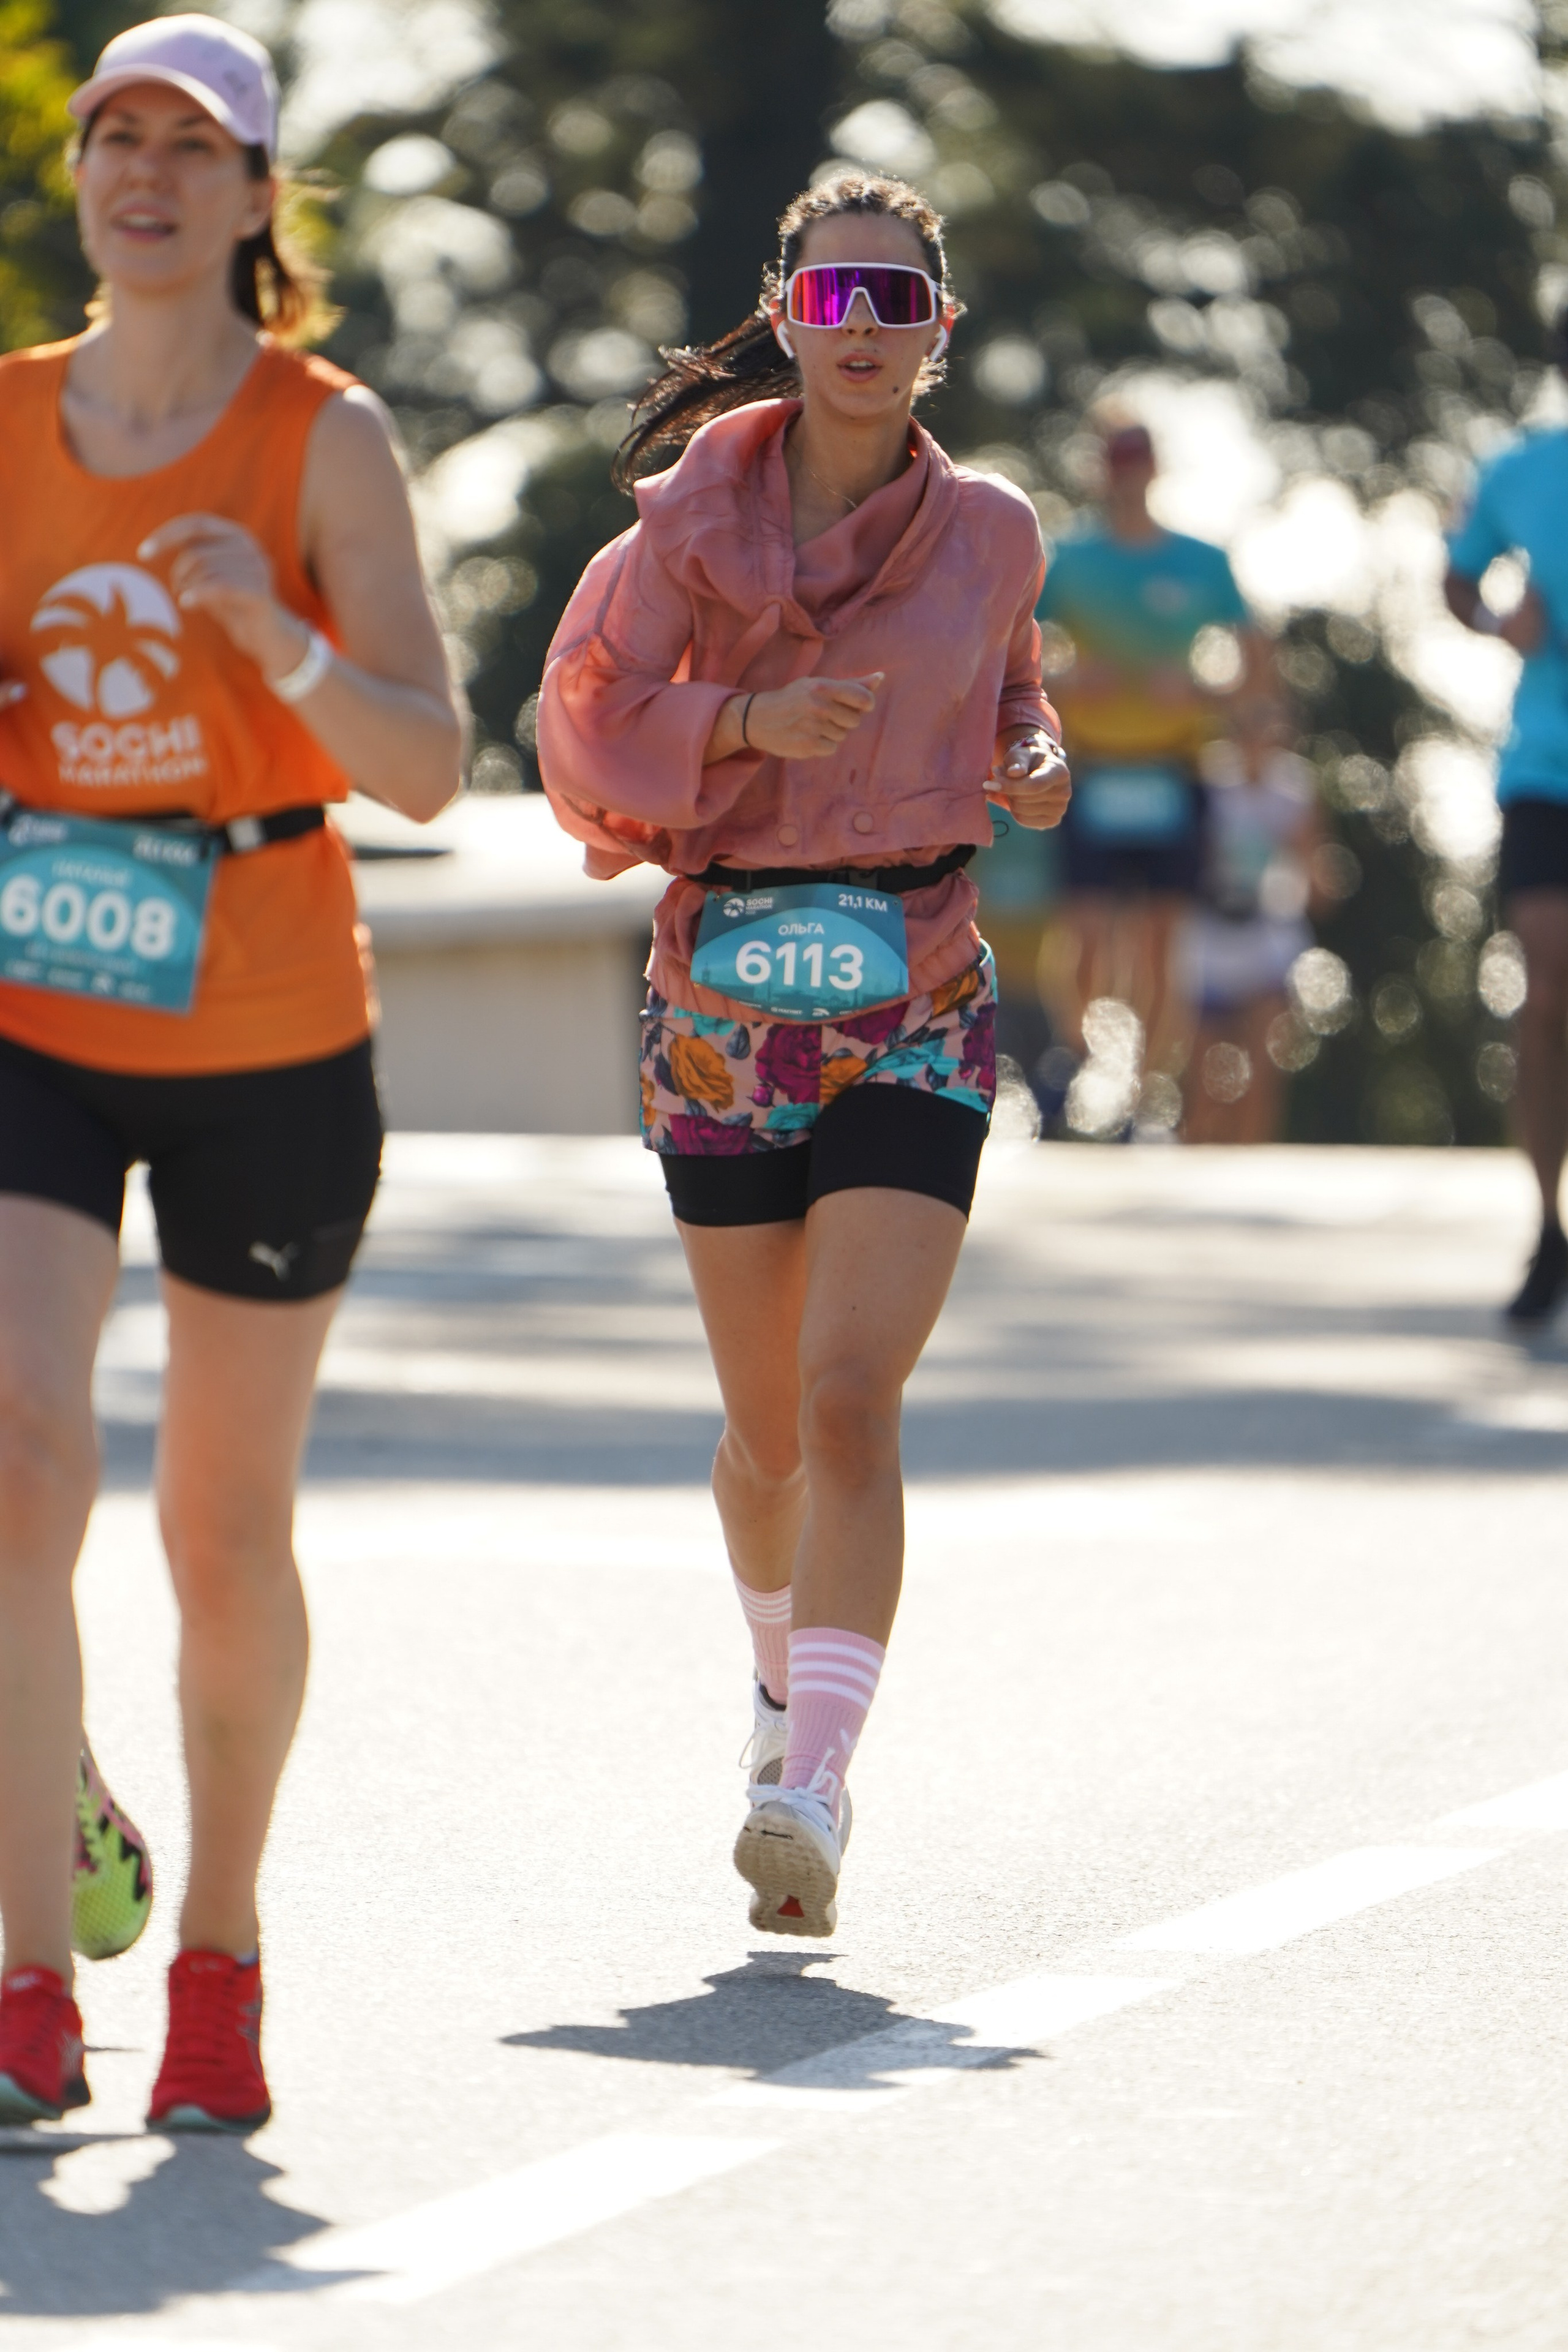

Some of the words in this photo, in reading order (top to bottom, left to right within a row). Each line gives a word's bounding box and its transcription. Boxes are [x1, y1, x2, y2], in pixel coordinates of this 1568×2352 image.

[50, 714, 201, 761] SOCHI
[0, 874, 176, 960] 6008
[746, 897, 773, 906] SOCHI
[838, 894, 862, 909] 21,1
[778, 922, 825, 936] ОЛЬГА
[736, 940, 864, 990] 6113
